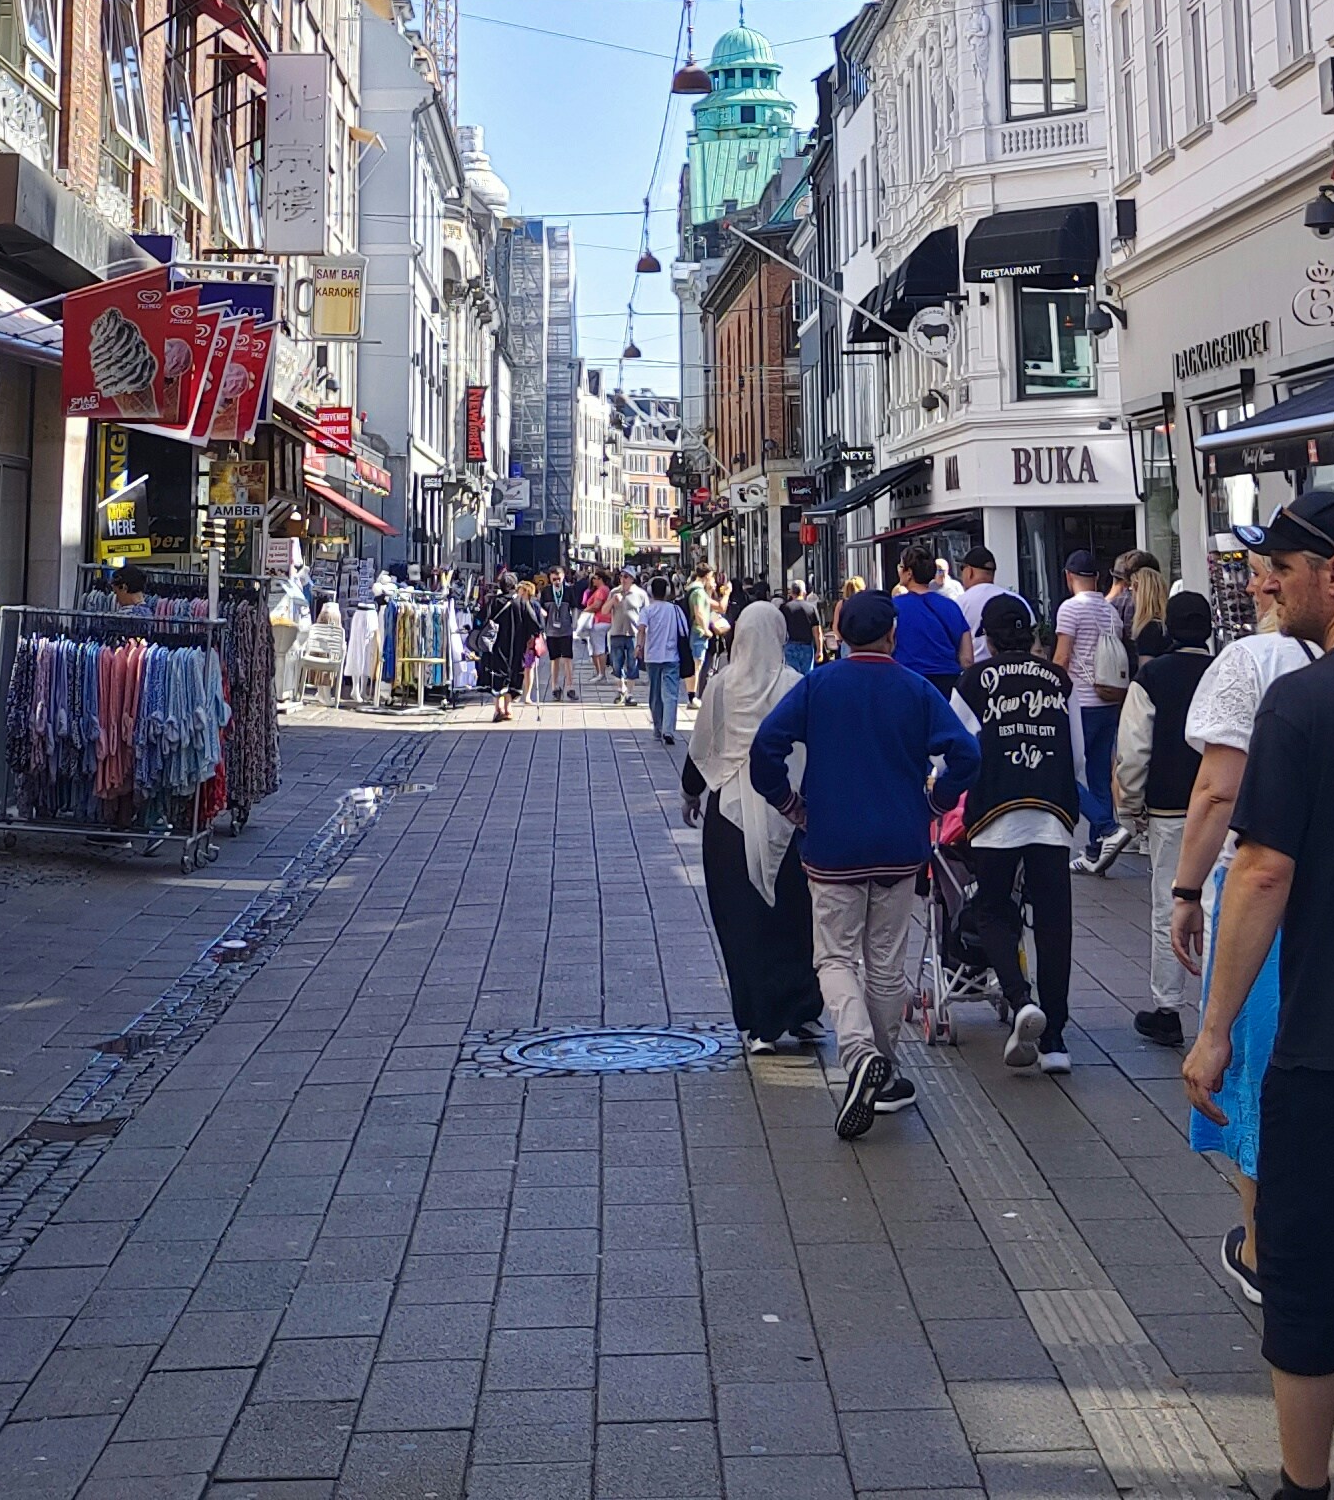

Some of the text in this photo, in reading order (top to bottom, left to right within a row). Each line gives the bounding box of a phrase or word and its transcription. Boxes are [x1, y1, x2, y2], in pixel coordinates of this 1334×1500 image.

[341, 268, 360, 280] BAR
[981, 265, 1042, 280] RESTAURANT
[315, 287, 360, 298] KARAOKE
[841, 451, 873, 461] NEYE
[1011, 445, 1099, 485] BUKA
[213, 505, 260, 517] AMBER
[108, 519, 137, 536] HERE
[980, 661, 1061, 695] Downtown
[982, 689, 1069, 724] New York
[998, 723, 1016, 736] BEST
[1038, 725, 1056, 736] CITY
